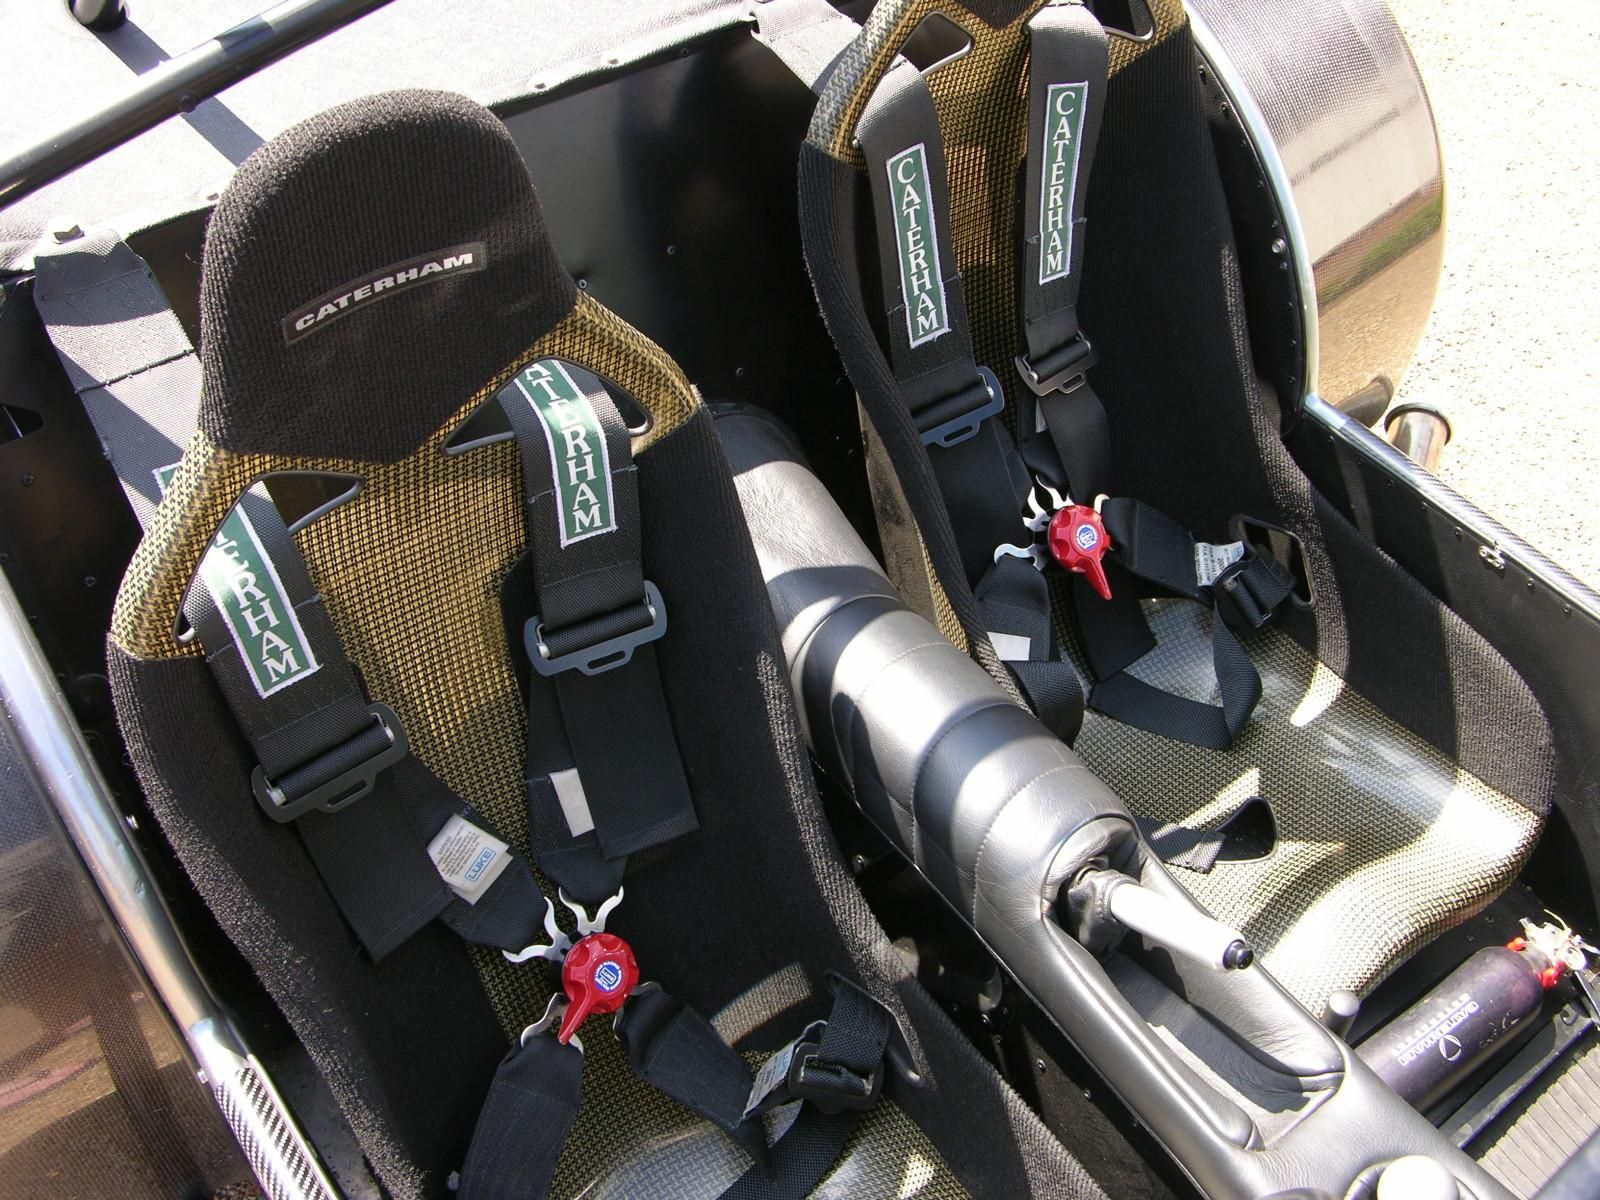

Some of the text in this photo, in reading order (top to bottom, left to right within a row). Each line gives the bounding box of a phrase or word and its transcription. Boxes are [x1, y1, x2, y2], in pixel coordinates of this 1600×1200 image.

[897, 158, 939, 336] CATERHAM
[1046, 91, 1075, 275] CATERHAM
[295, 253, 473, 331] CATERHAM
[525, 363, 602, 533] ATERHAM
[467, 849, 493, 880] LUKE
